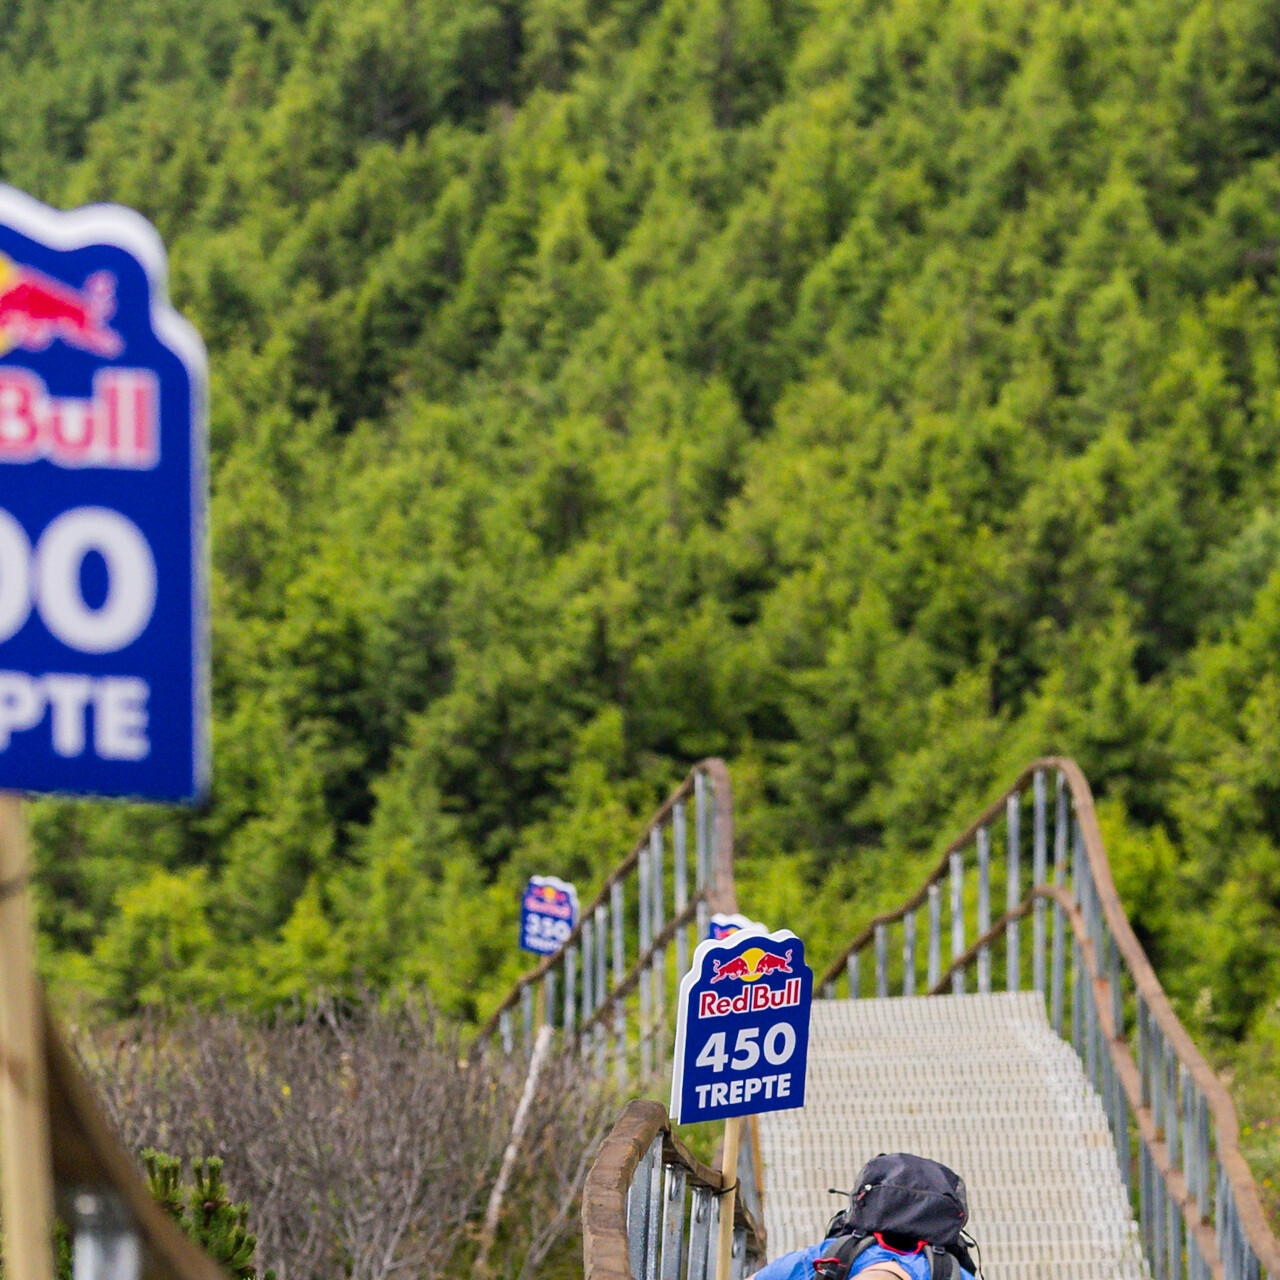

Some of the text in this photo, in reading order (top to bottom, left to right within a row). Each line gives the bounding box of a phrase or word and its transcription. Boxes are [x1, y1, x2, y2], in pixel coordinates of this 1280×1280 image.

[699, 977, 801, 1018] Red Bull
[696, 1022, 796, 1073] 450
[695, 1073, 791, 1109] TREPTE
